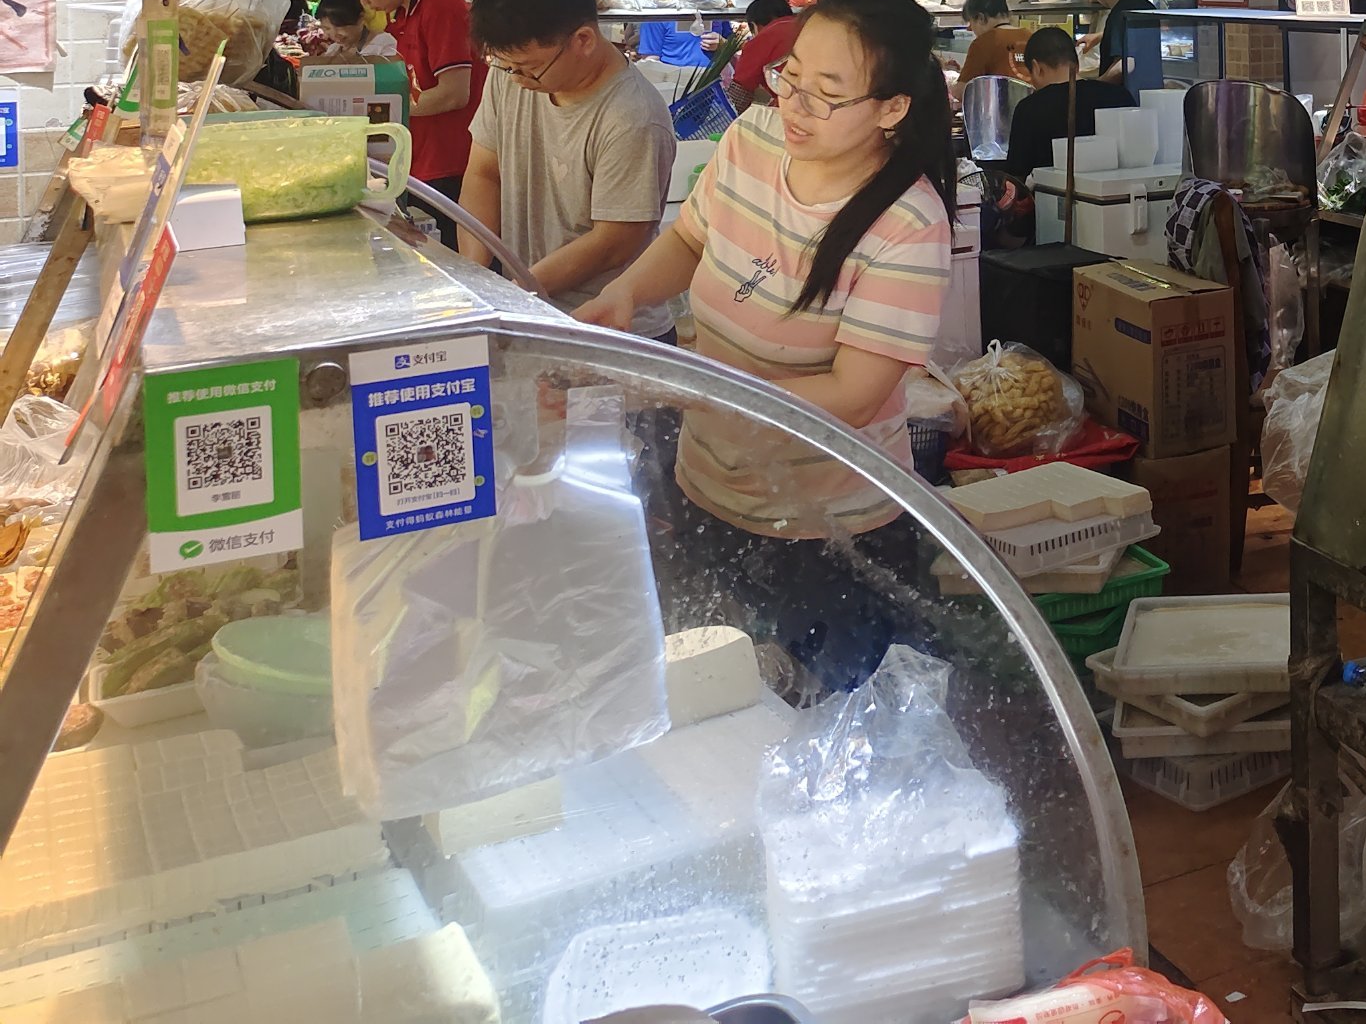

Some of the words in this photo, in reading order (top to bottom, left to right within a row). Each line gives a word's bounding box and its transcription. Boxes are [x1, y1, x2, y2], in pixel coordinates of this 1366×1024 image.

[413, 351, 447, 366] 支付宝
[166, 379, 277, 404] 推荐使用微信支付
[367, 378, 476, 408] 推荐使用支付宝
[209, 529, 275, 553] 微信支付
